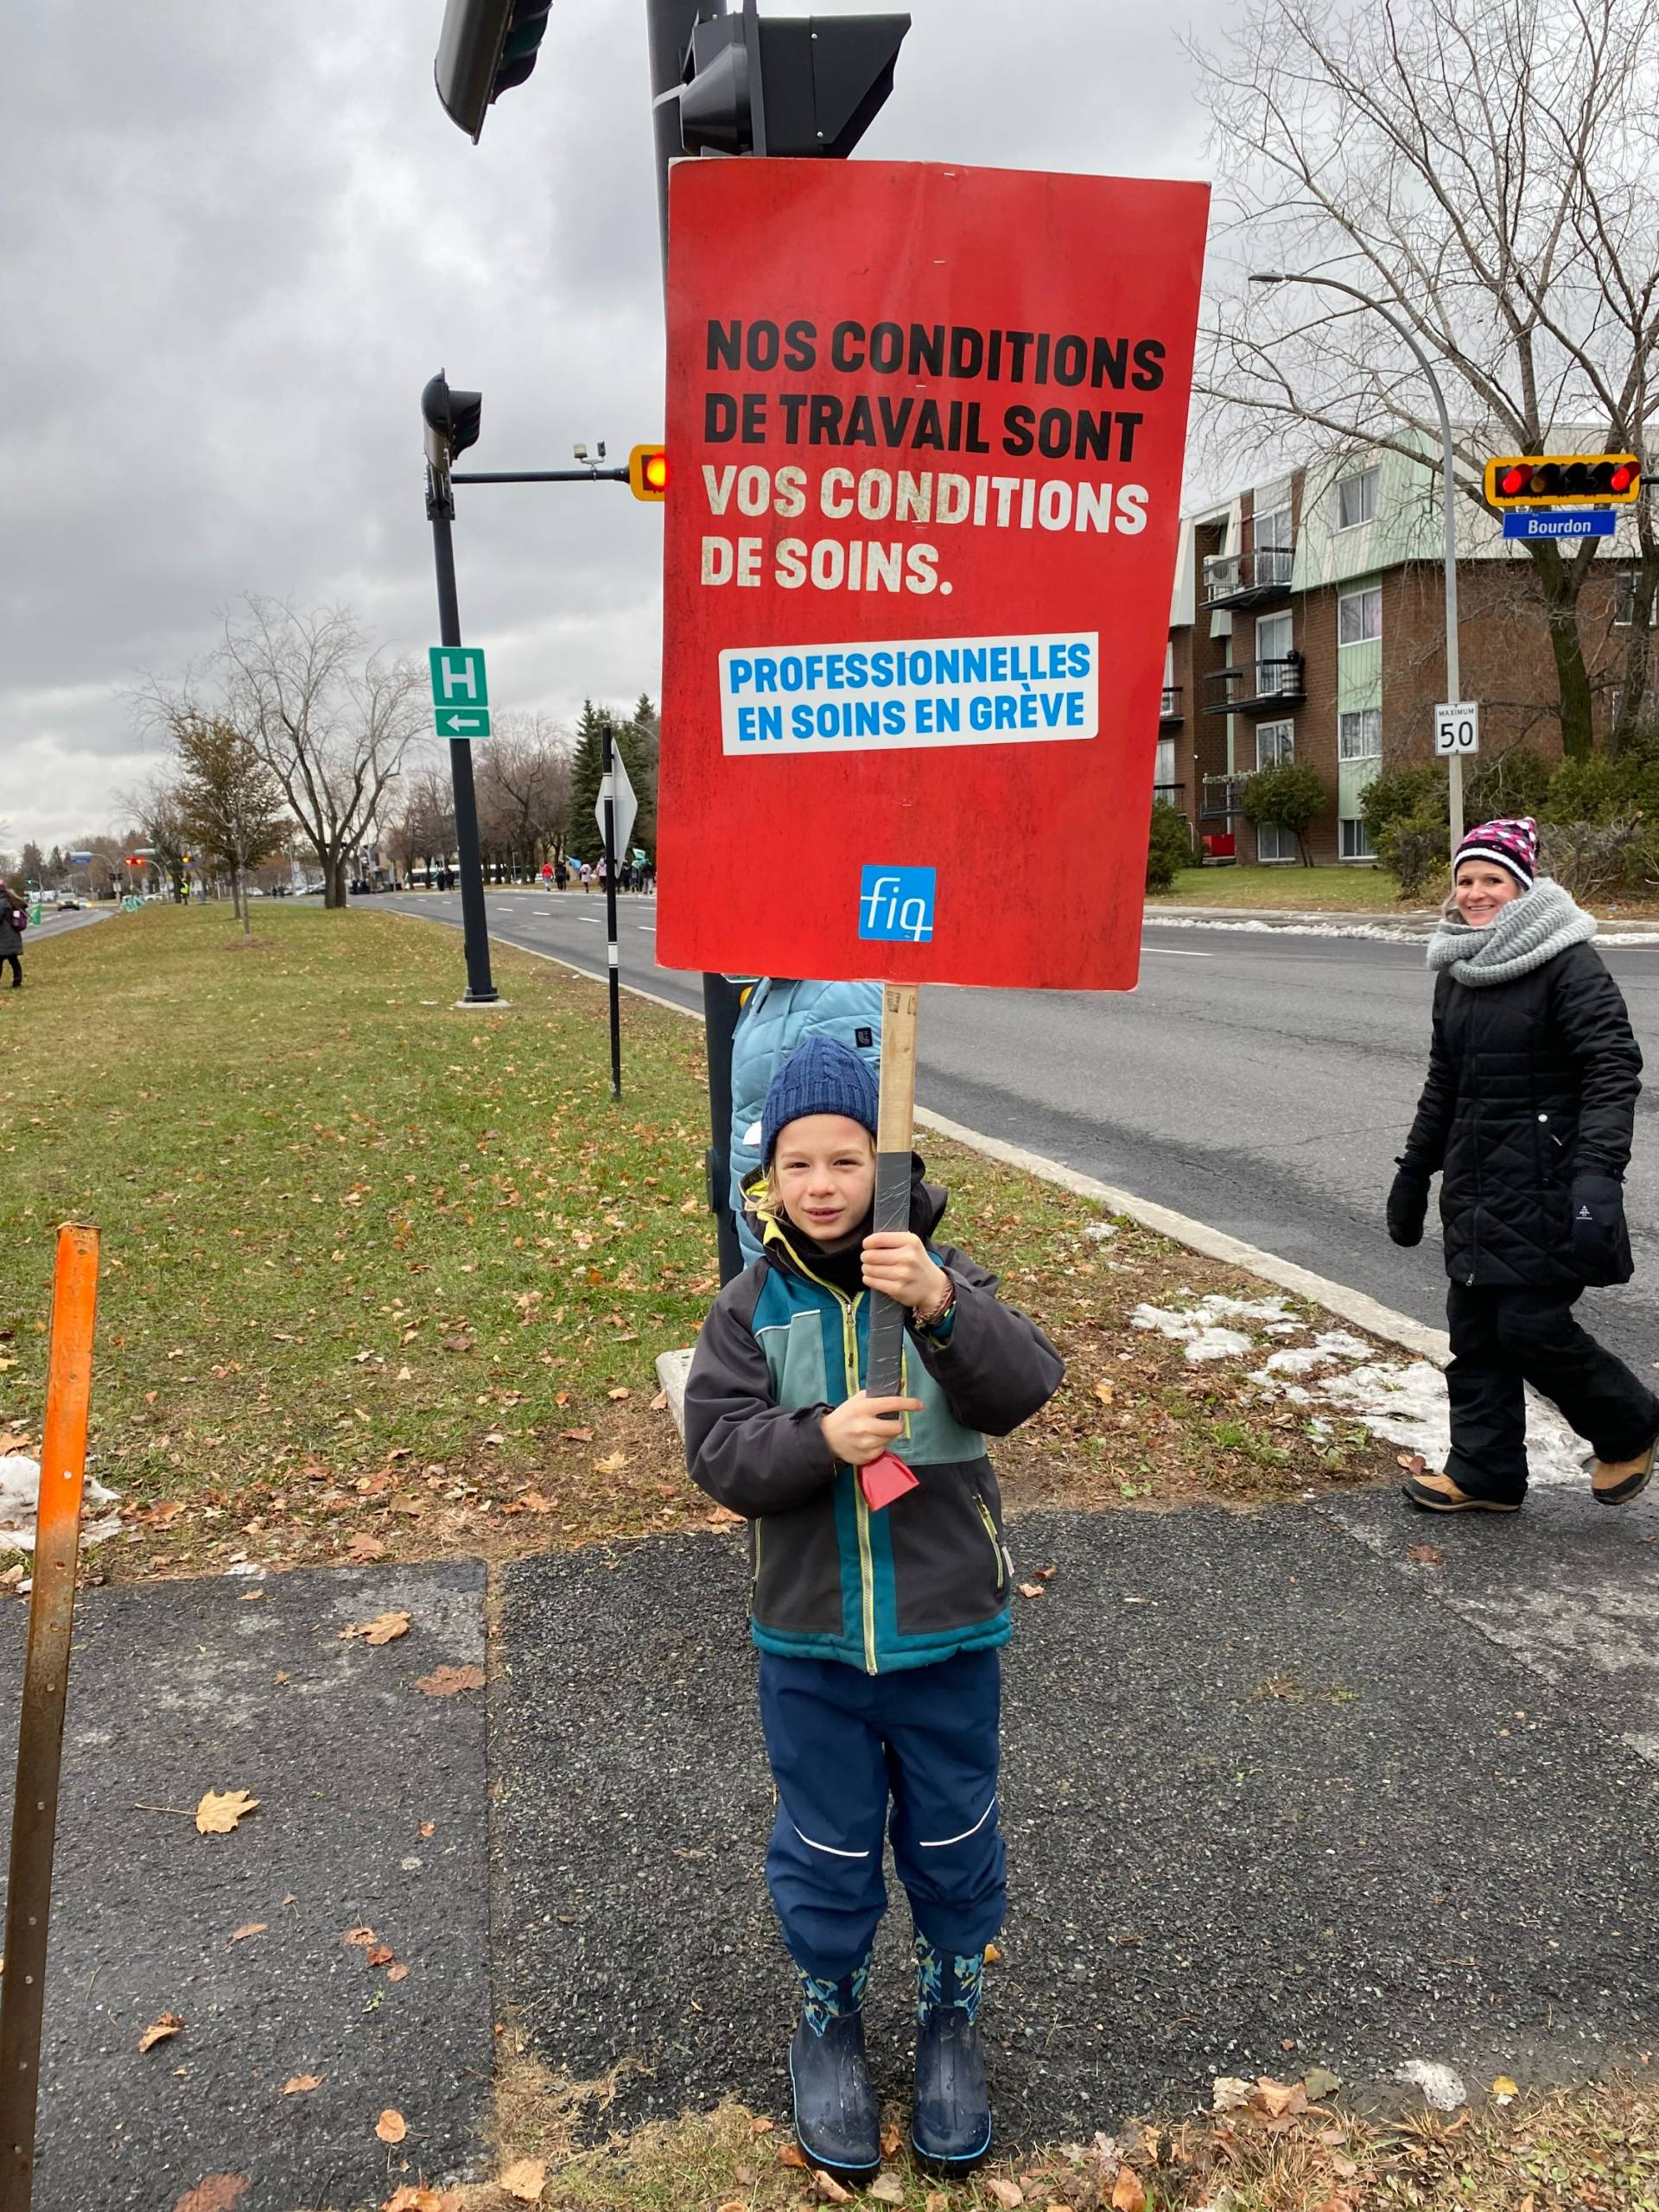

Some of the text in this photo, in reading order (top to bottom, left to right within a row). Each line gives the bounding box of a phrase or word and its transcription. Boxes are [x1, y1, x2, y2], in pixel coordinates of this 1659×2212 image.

[707, 320, 1166, 391] NOS CONDITIONS
[704, 393, 1143, 462] DE TRAVAIL SONT
[702, 464, 1149, 535] VOS CONDITIONS
[1528, 518, 1591, 534] Bourdon
[701, 536, 953, 595] DE SOINS.
[441, 656, 477, 699] H
[729, 643, 1090, 694] PROFESSIONNELLES
[738, 683, 1084, 741] EN SOINS EN GRÈVE
[1440, 721, 1473, 748] 50
[861, 876, 933, 942] fiq
